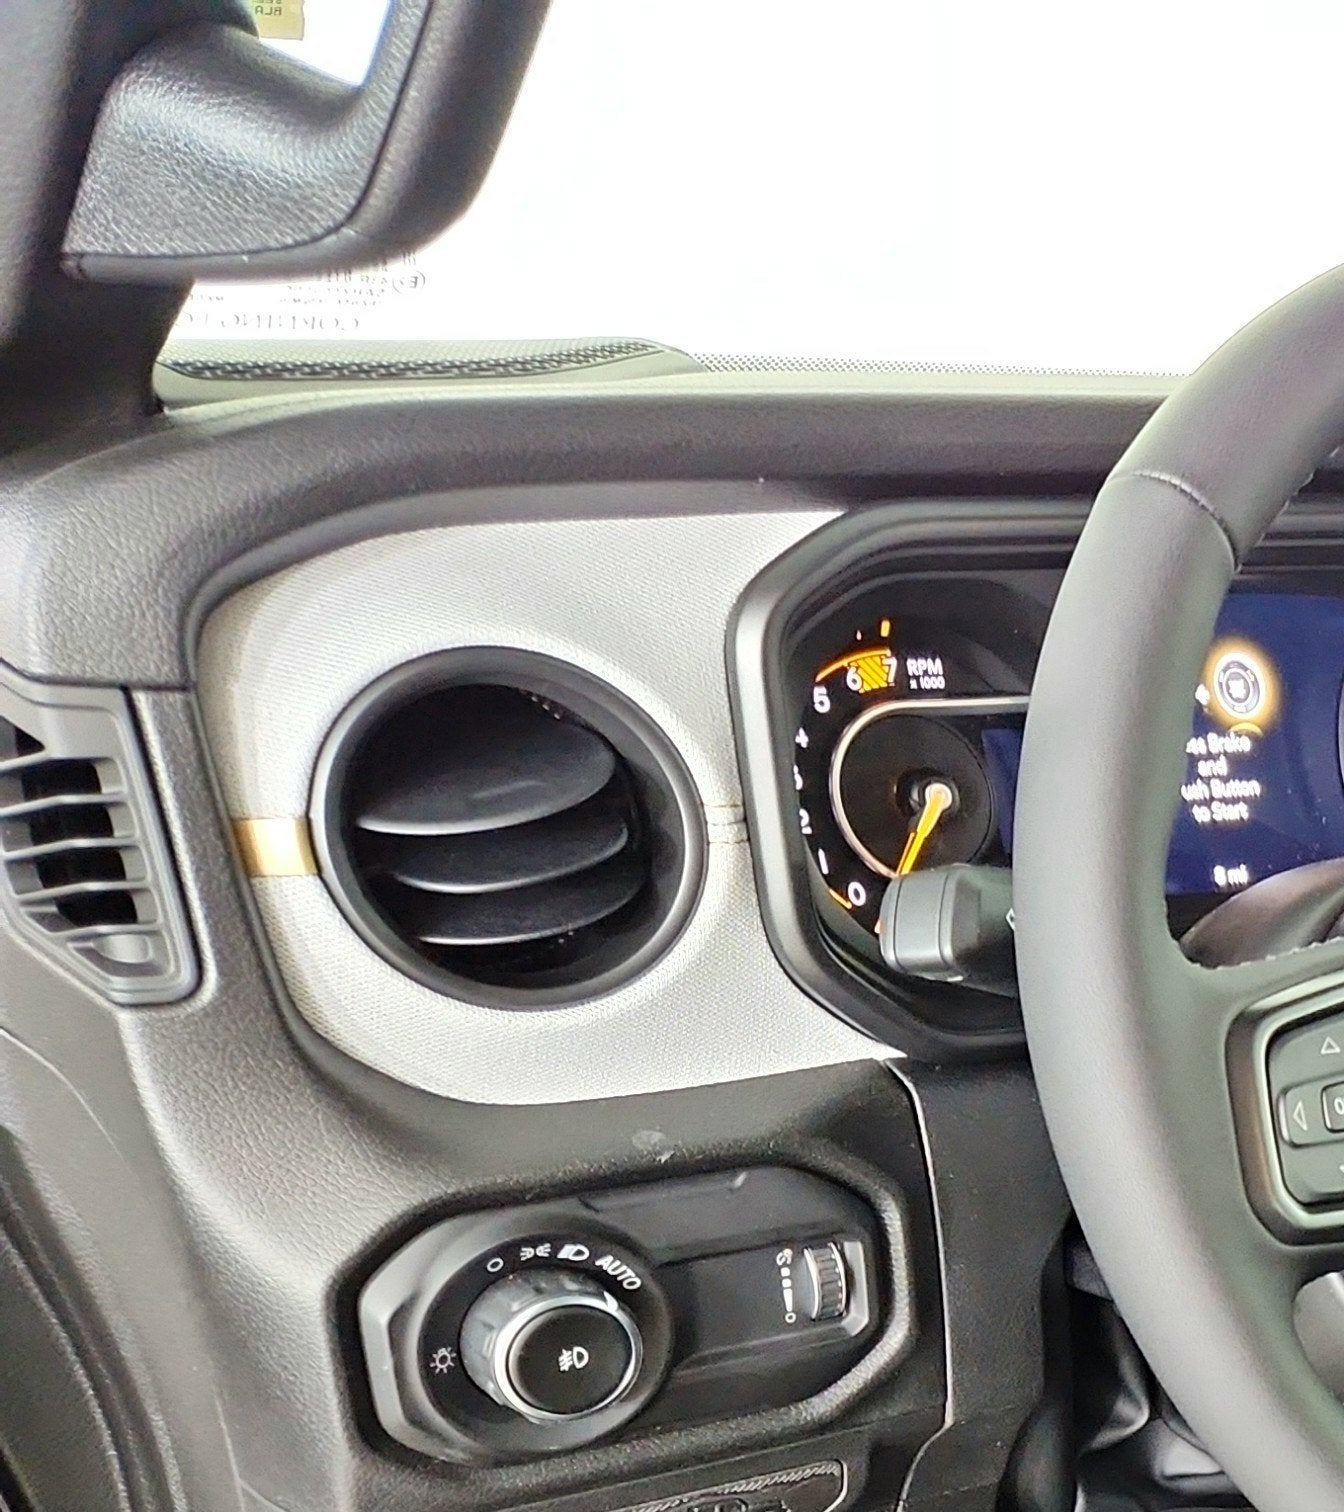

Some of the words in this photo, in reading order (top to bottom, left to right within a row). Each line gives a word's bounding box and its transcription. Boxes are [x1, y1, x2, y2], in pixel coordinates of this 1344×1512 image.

[846, 664, 862, 691] 6
[883, 658, 897, 685] 7
[906, 657, 944, 676] RPM
[813, 686, 831, 714] 5
[1180, 778, 1209, 801] ush
[1211, 800, 1249, 822] Start
[817, 848, 829, 875] 1
[847, 880, 867, 906] 0
[594, 1254, 642, 1290] AUTO
